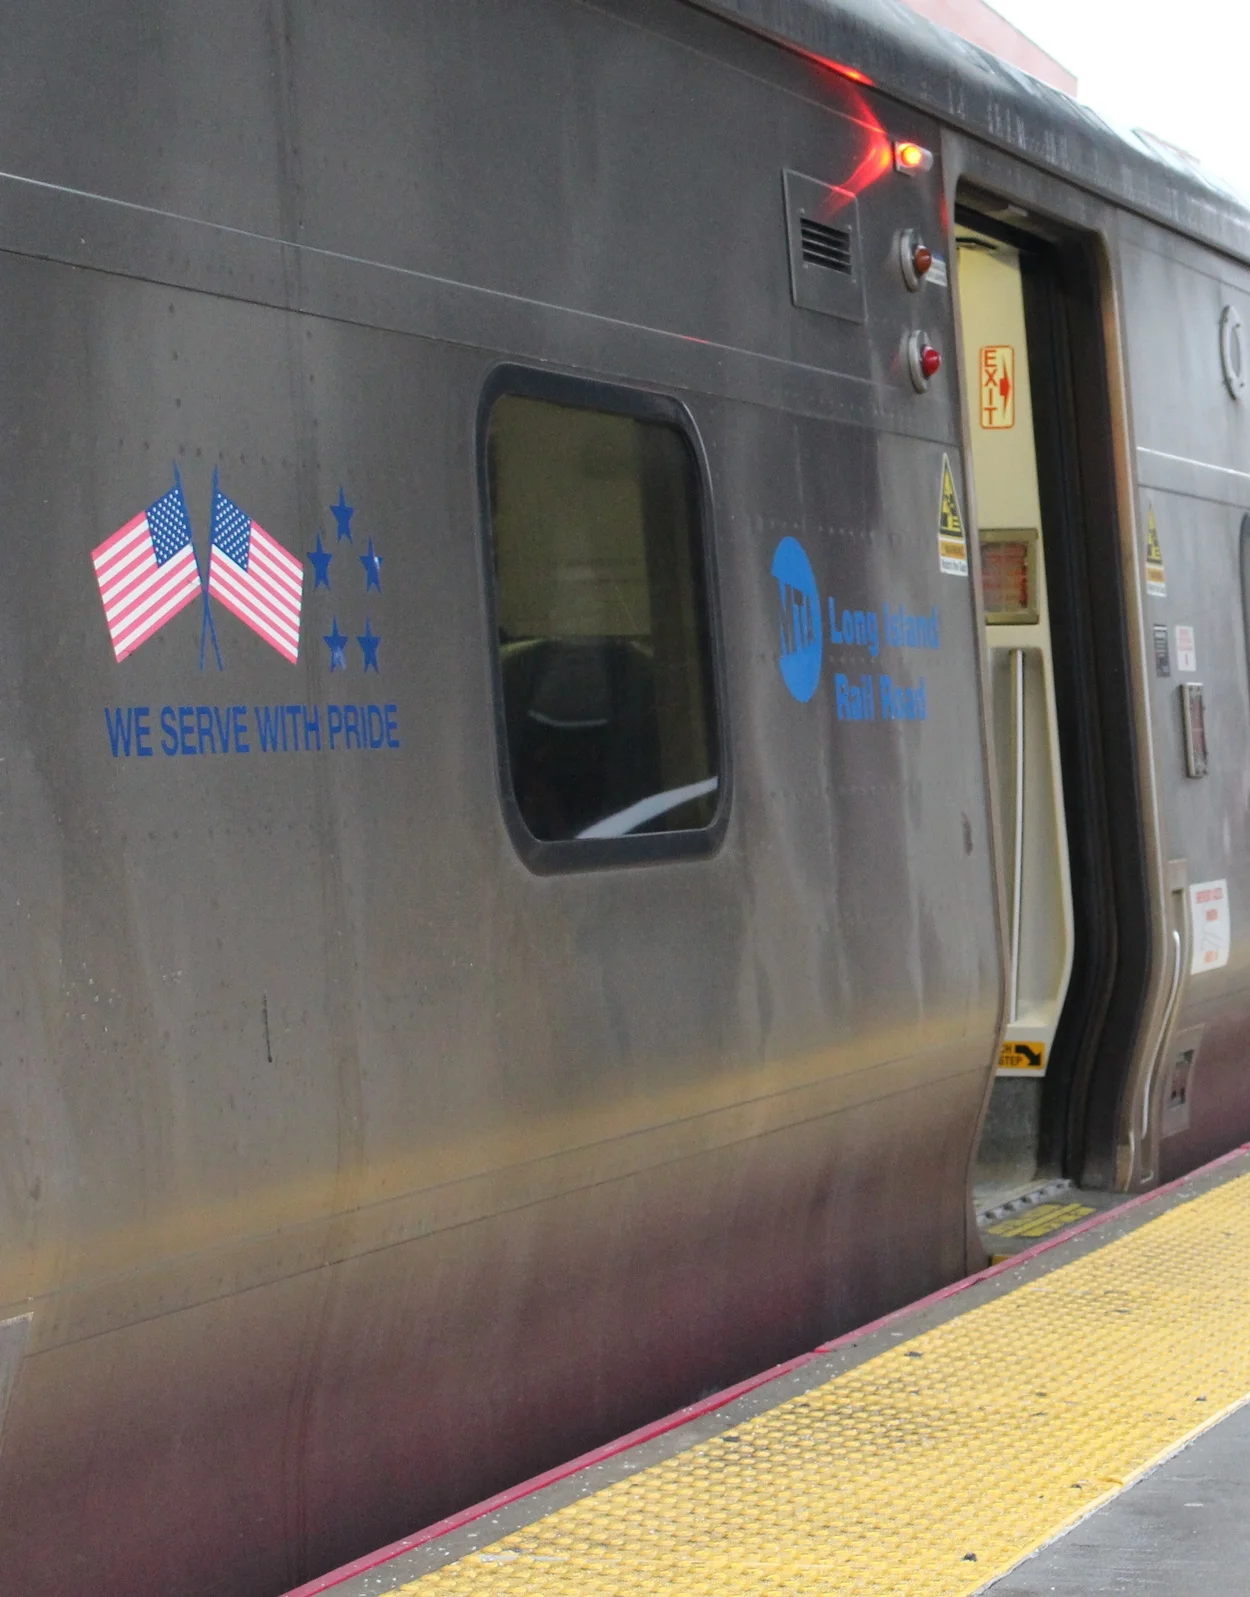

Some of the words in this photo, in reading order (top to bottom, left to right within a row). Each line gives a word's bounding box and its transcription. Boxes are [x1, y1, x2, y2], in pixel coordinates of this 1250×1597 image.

[984, 349, 998, 425] EXIT
[828, 596, 880, 657] Long
[883, 600, 940, 650] Island
[834, 672, 875, 721] Rail
[879, 674, 928, 721] Road
[104, 706, 153, 758] WE
[159, 705, 250, 757] SERVE
[254, 704, 321, 752] WITH
[326, 704, 399, 750] PRIDE
